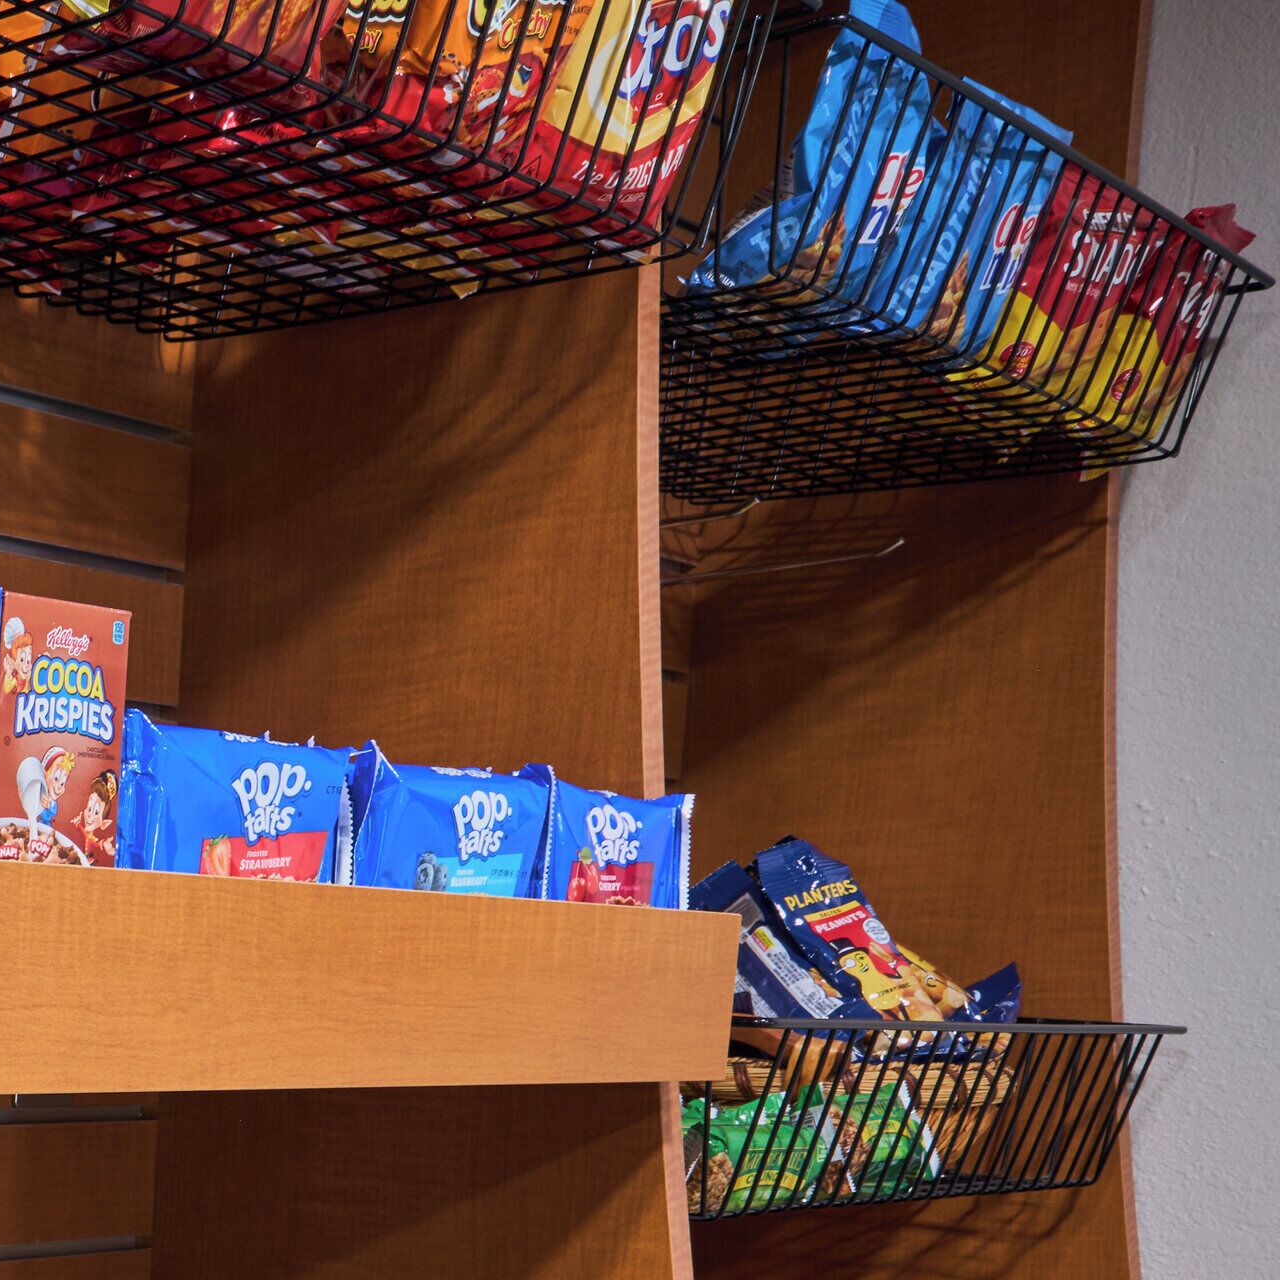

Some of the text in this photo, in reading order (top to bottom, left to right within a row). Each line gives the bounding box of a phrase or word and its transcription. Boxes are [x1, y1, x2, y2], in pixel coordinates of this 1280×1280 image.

[47, 627, 90, 655] Kellogg's
[32, 659, 105, 702] COCOA
[16, 694, 113, 741] KRISPIES
[244, 804, 296, 842] tarts
[458, 828, 504, 861] tarts
[595, 838, 639, 866] tarts
[240, 857, 291, 870] STRAWBERRY
[598, 881, 622, 892] CHERRY
[784, 879, 858, 912] PLANTERS
[815, 911, 866, 934] PEANUTS
